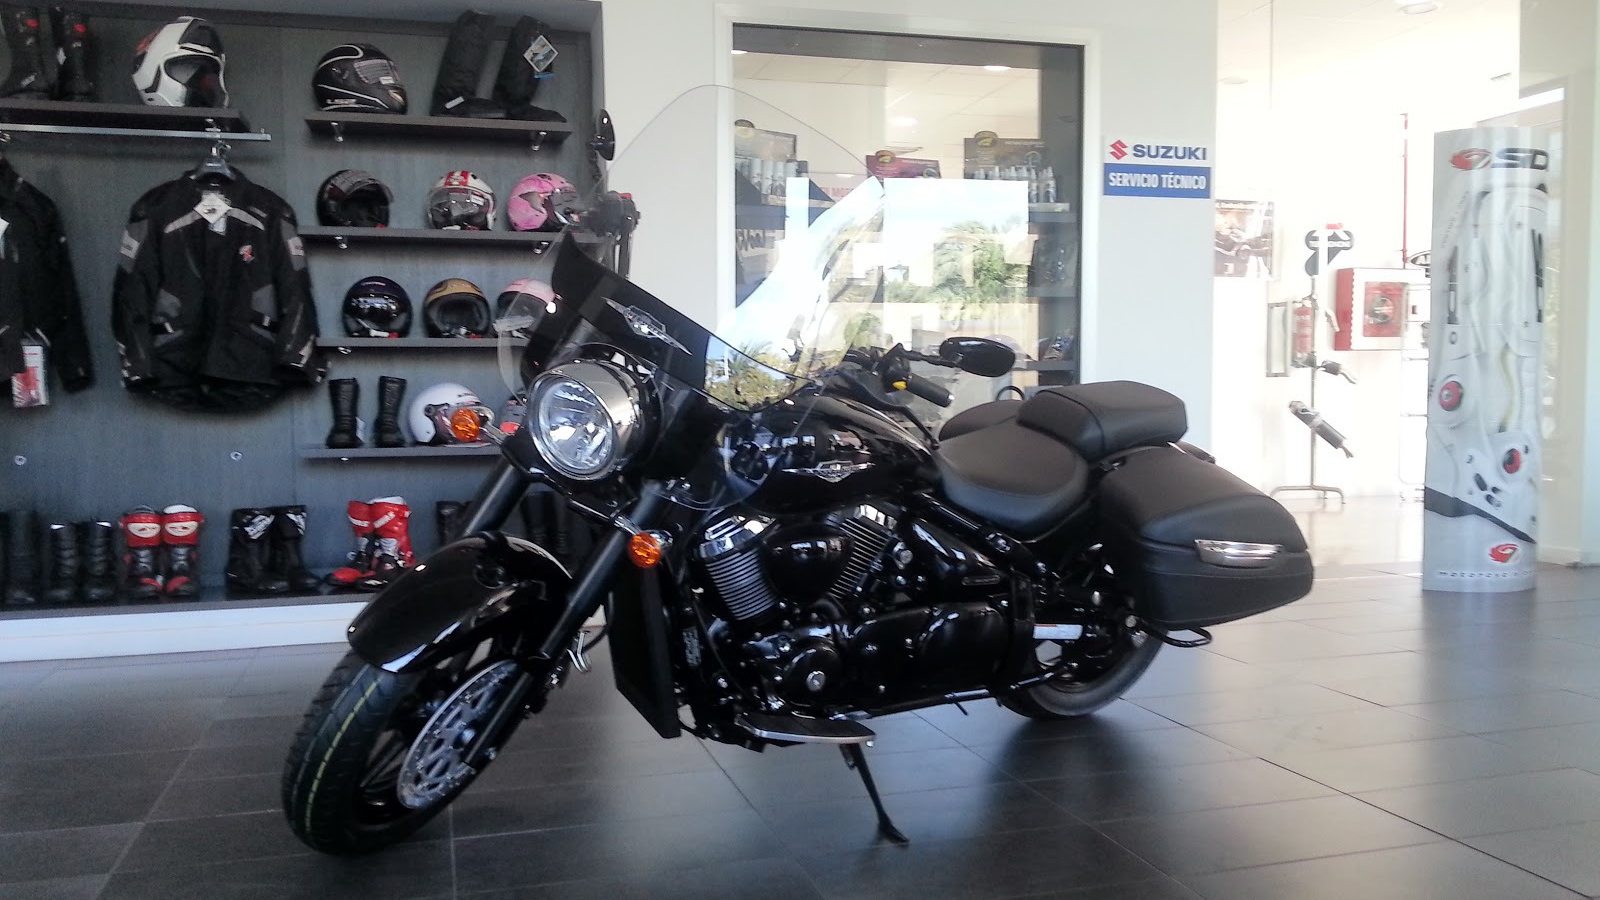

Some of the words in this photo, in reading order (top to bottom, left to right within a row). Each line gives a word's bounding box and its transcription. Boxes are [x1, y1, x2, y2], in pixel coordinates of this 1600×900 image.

[1133, 144, 1207, 160] SUZUKI
[1108, 172, 1159, 188] SERVICIO
[1161, 171, 1207, 190] TÉCNICO
